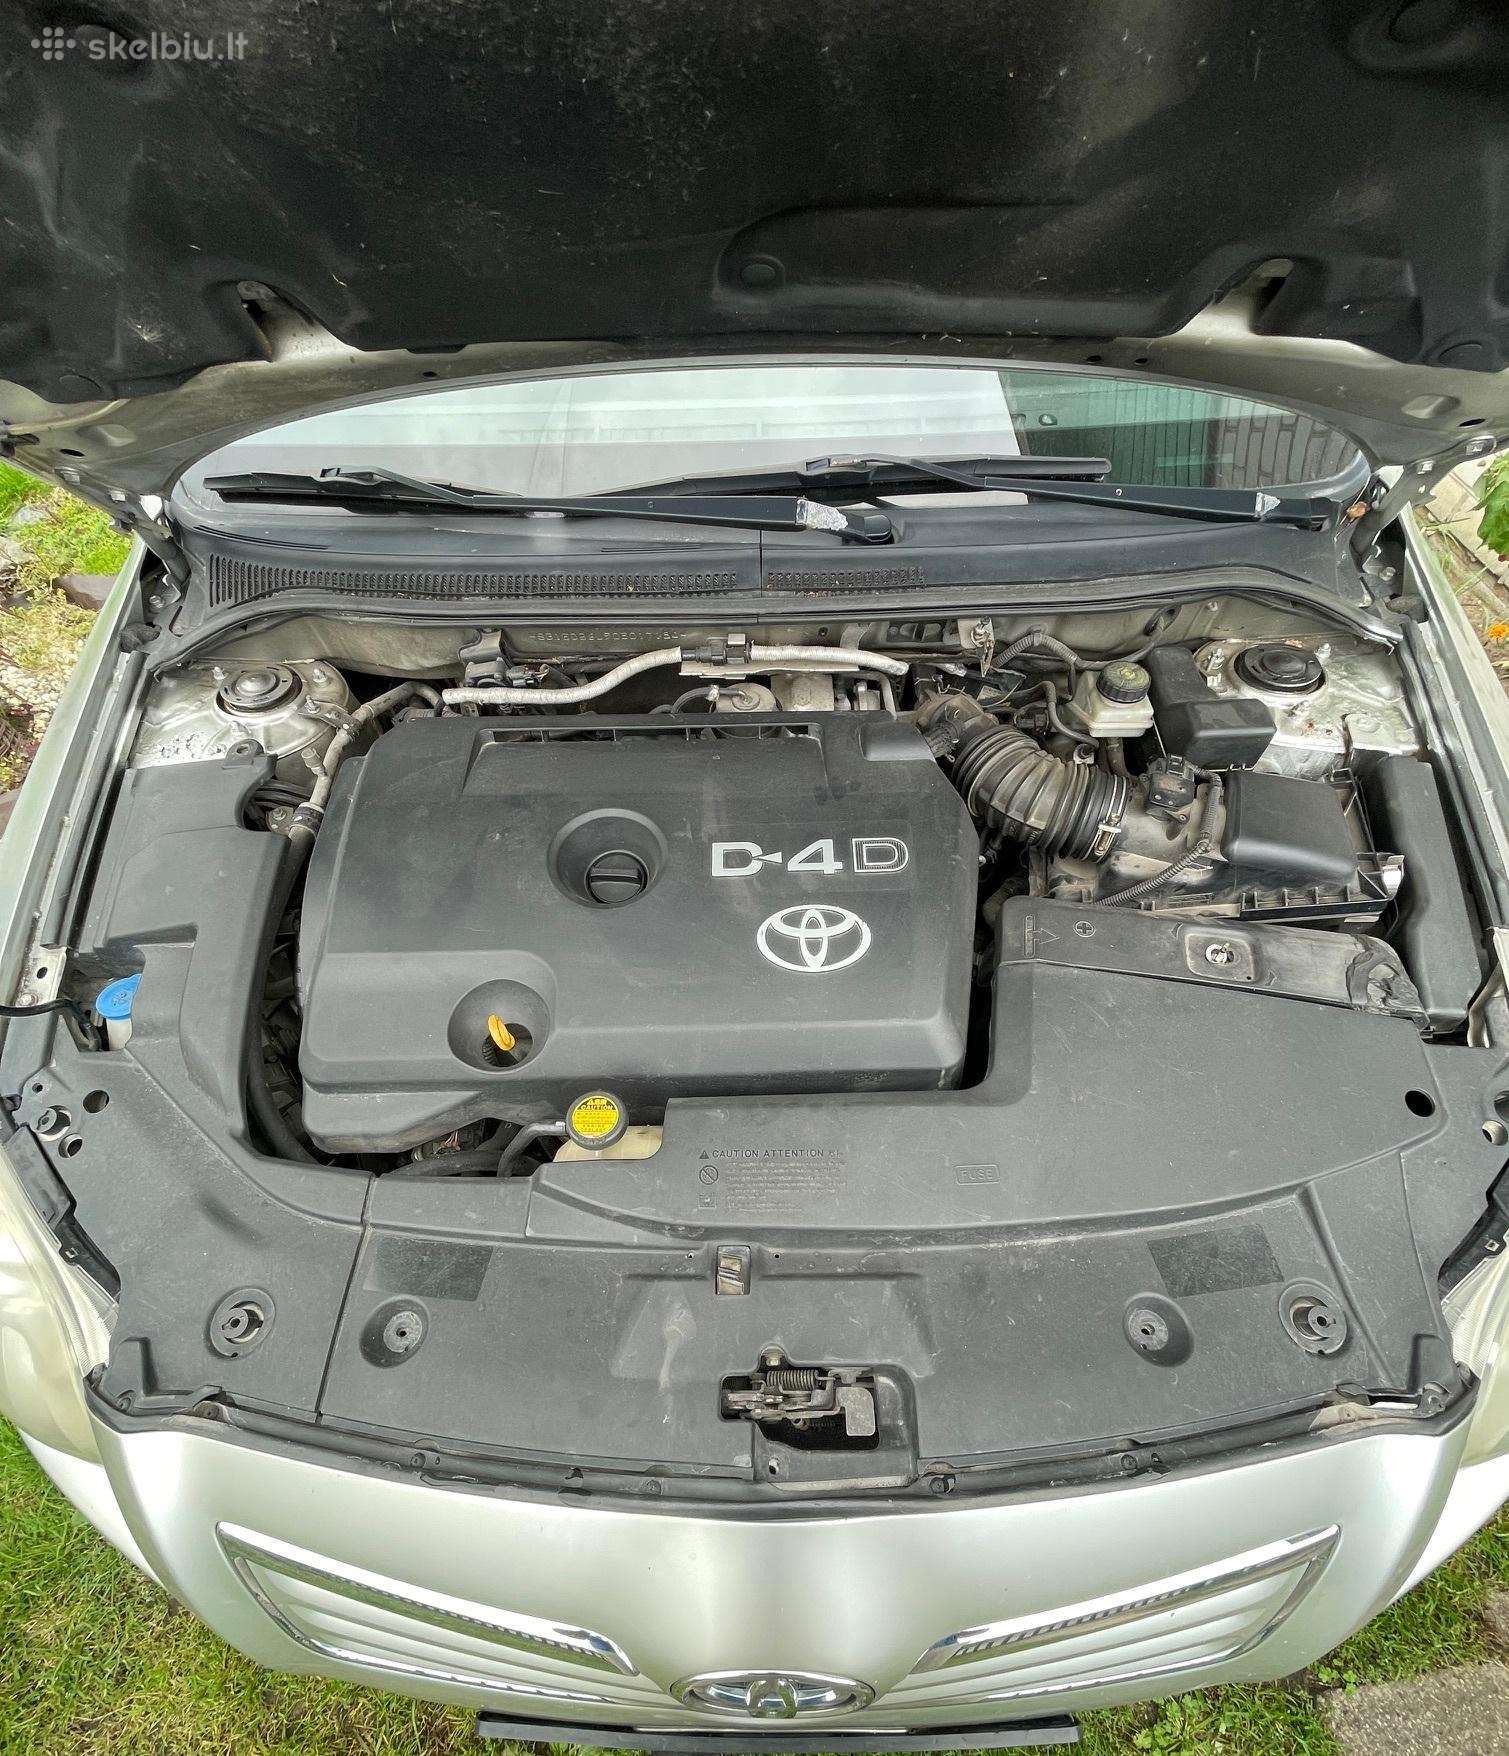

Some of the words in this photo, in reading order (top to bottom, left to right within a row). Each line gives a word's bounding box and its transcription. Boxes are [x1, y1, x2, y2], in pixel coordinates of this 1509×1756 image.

[711, 837, 909, 877] D-4D
[712, 1149, 760, 1159] CAUTION
[763, 1149, 825, 1159] ATTENTION
[959, 1168, 994, 1181] FUSE
